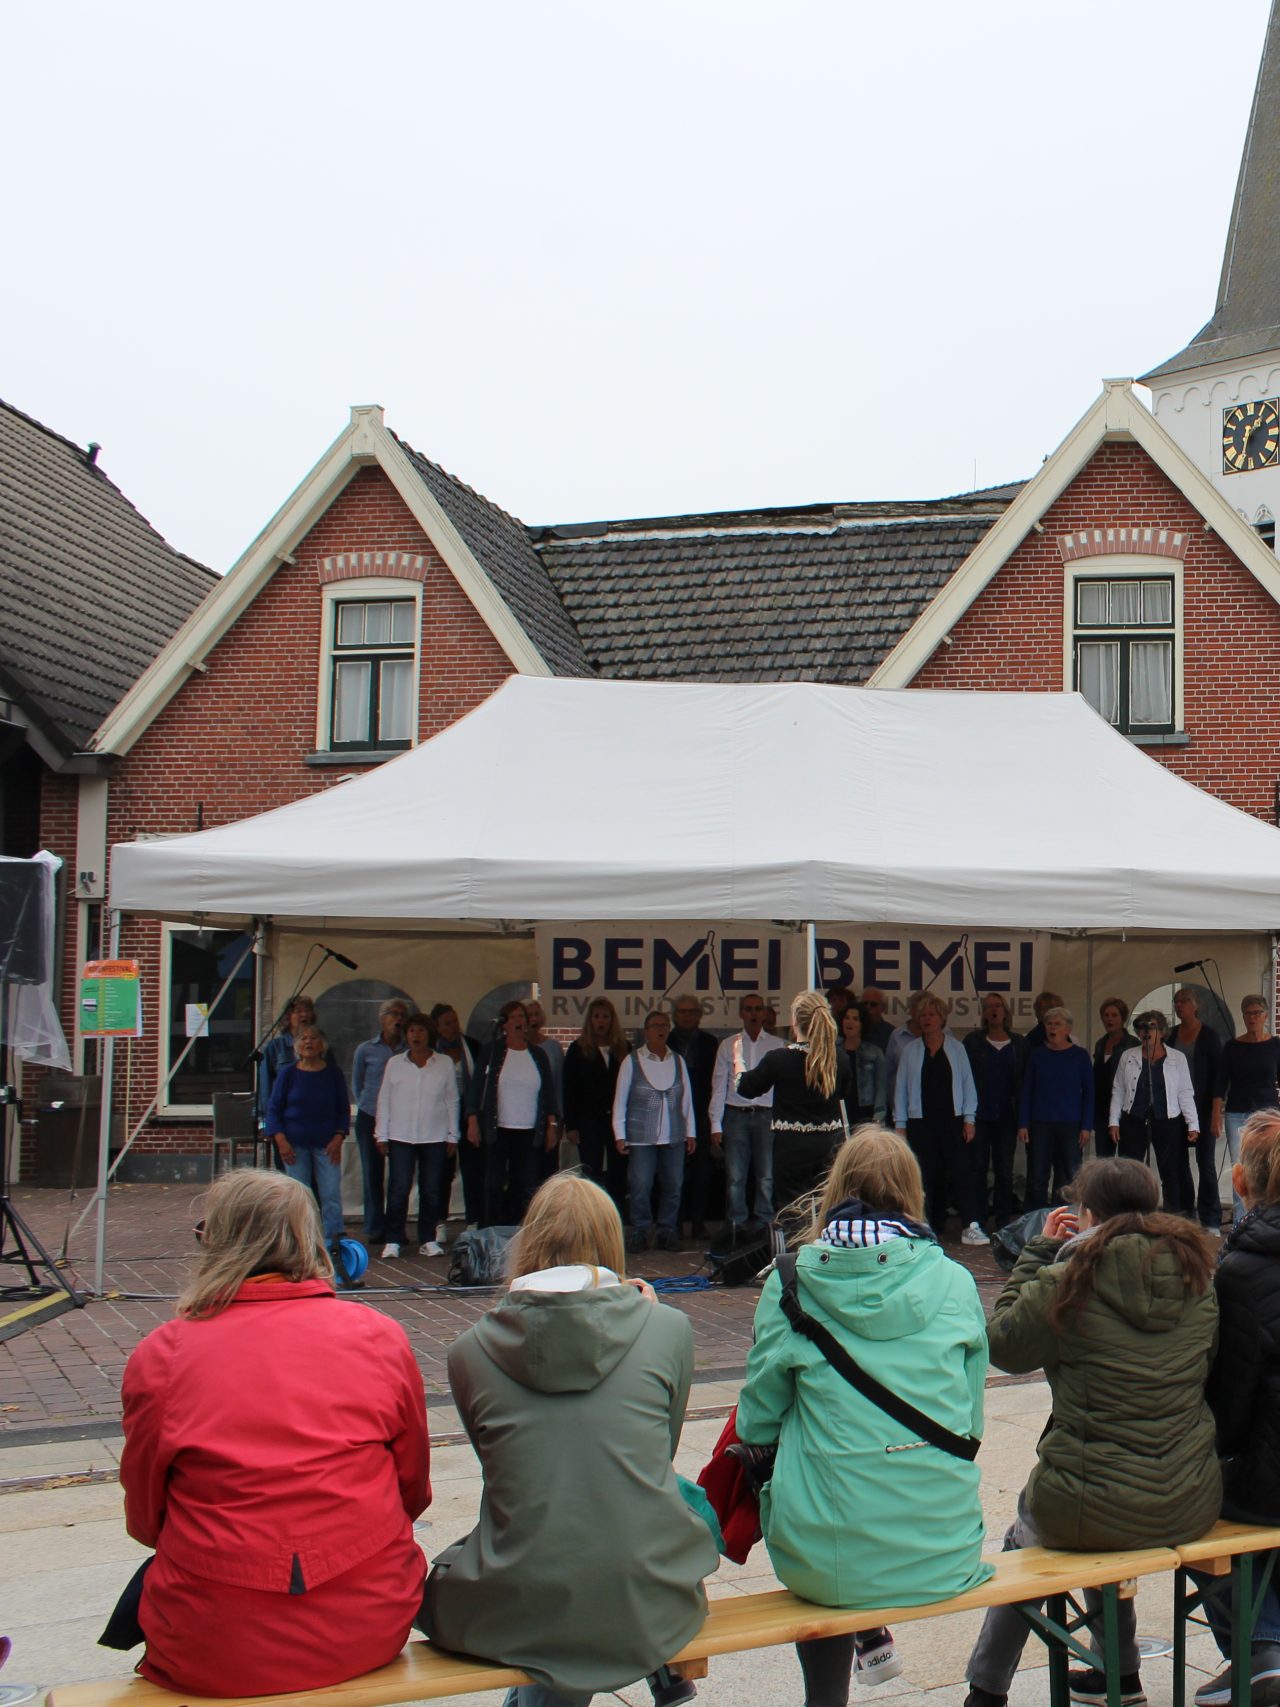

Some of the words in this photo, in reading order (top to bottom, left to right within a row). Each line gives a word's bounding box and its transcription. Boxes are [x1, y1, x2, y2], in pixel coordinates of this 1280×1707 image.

[552, 934, 782, 991] BEMEI
[814, 937, 1034, 992] BEMEI
[867, 1651, 894, 1667] adidas
